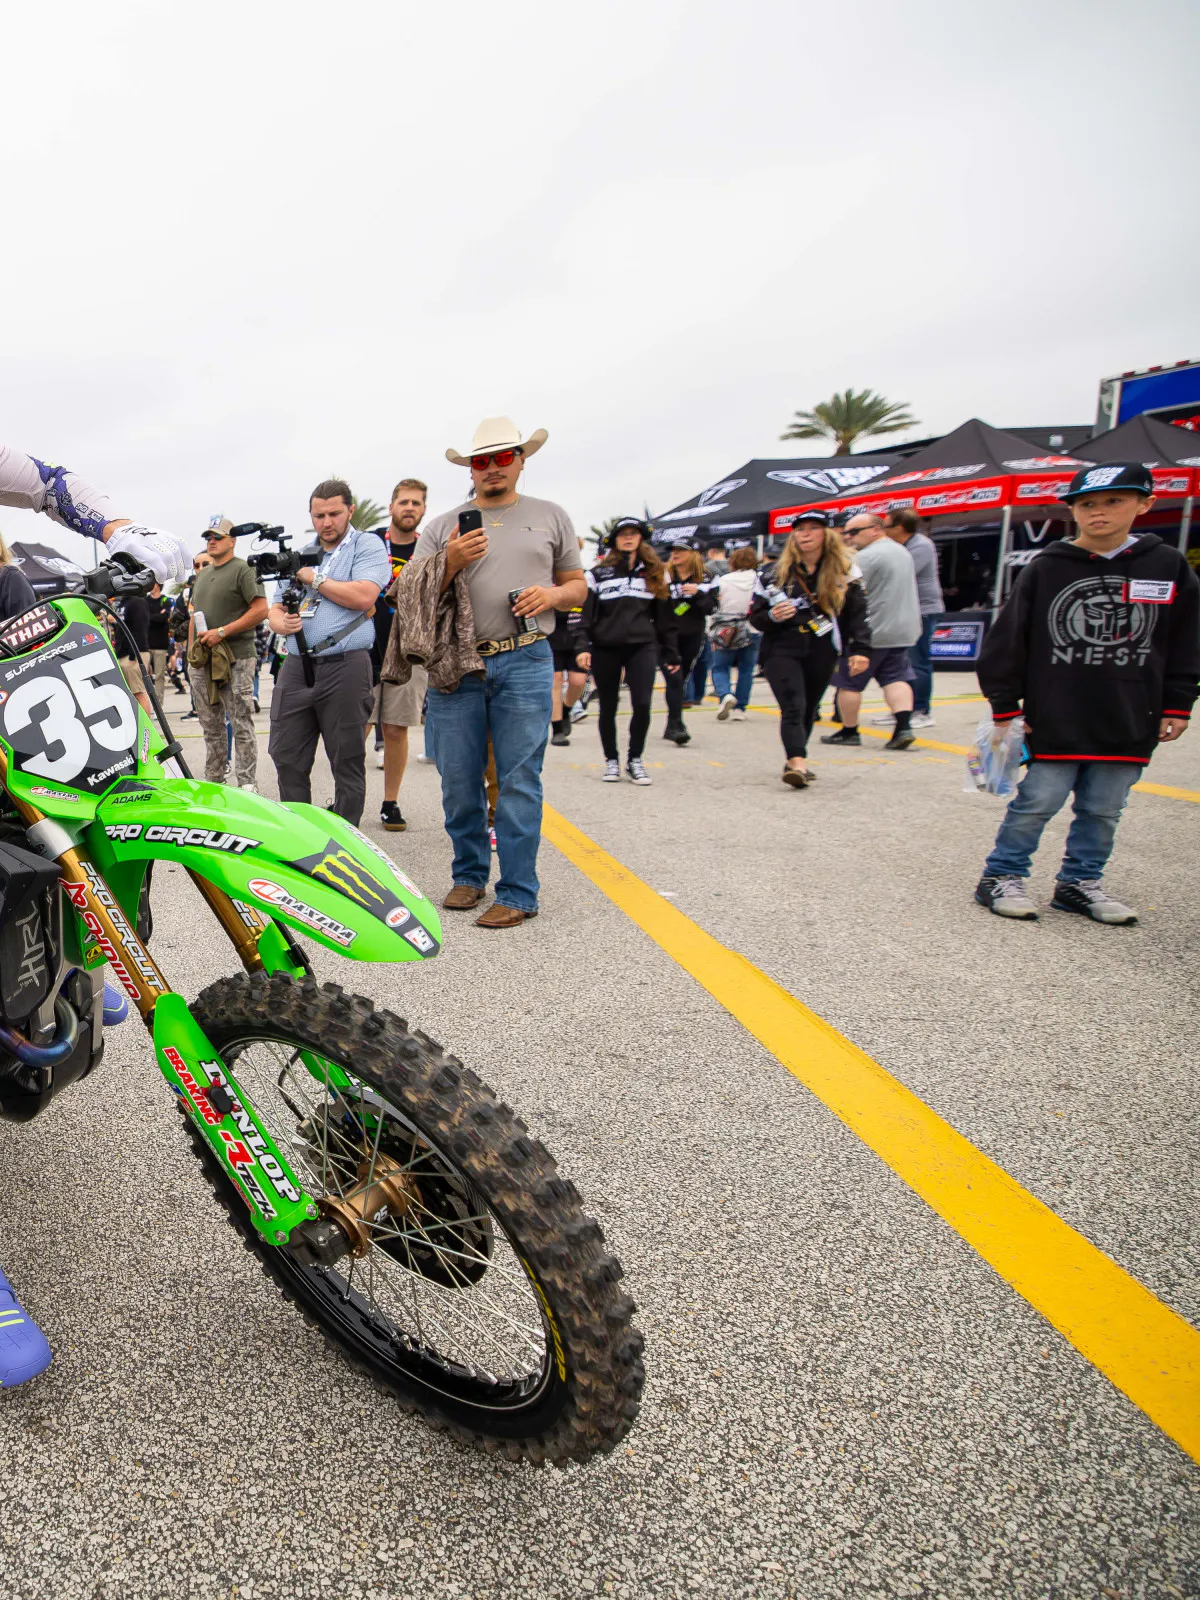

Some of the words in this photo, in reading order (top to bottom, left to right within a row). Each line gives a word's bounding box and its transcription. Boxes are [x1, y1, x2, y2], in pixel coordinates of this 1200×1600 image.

[4, 640, 79, 682] SUPERCROSS
[4, 648, 137, 783] 35
[87, 754, 135, 787] Kawasaki
[111, 794, 152, 805] ADAMS
[105, 824, 143, 841] PRO
[145, 826, 263, 853] CIRCUIT
[78, 861, 115, 907] PRO
[106, 908, 165, 991] CIRCUIT
[277, 895, 357, 942] MAXIMA
[389, 910, 408, 926] BELL
[162, 1046, 221, 1126] BRAKING
[373, 1204, 388, 1226] 35
